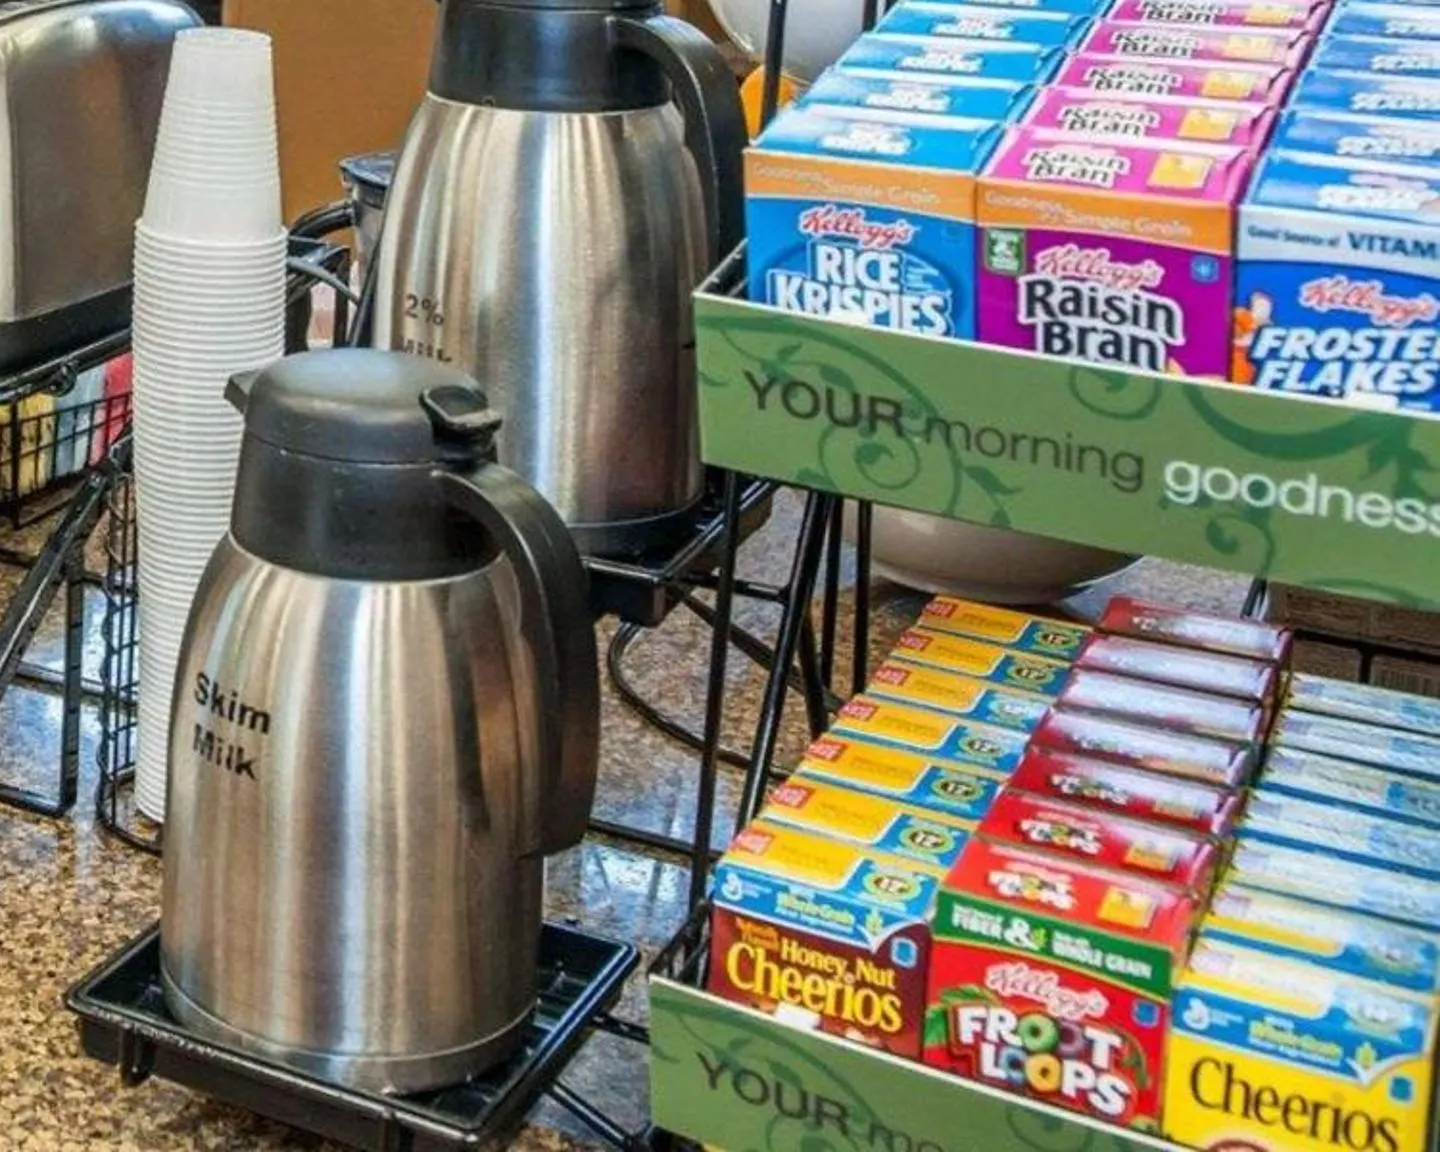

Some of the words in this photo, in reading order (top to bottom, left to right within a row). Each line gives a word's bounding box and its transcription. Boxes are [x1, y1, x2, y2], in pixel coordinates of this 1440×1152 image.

[1029, 150, 1127, 172] Raisin
[1034, 162, 1110, 184] Bran
[799, 203, 913, 248] Kellogg's
[815, 244, 901, 291] RICE
[1036, 243, 1165, 288] Kellogg's
[404, 293, 445, 326] 2%
[773, 273, 949, 338] KRISPIES
[1023, 278, 1177, 340] Raisin
[1300, 275, 1439, 327] Kellogg's
[1042, 321, 1165, 372] Bran
[1252, 327, 1440, 361] FROSTE
[1257, 359, 1436, 395] FLAKES
[742, 369, 905, 438] YOUR
[922, 417, 1144, 494] morning
[194, 671, 271, 735] Skim
[192, 723, 259, 782] Milk
[726, 940, 903, 1033] Cheerios
[780, 937, 848, 983] Honey
[855, 956, 896, 991] Nut
[986, 963, 1109, 1020] Kellogg's
[695, 1051, 850, 1137] YOUR
[980, 1042, 1133, 1116] LOOPS
[1189, 1056, 1400, 1152] Cheerios
